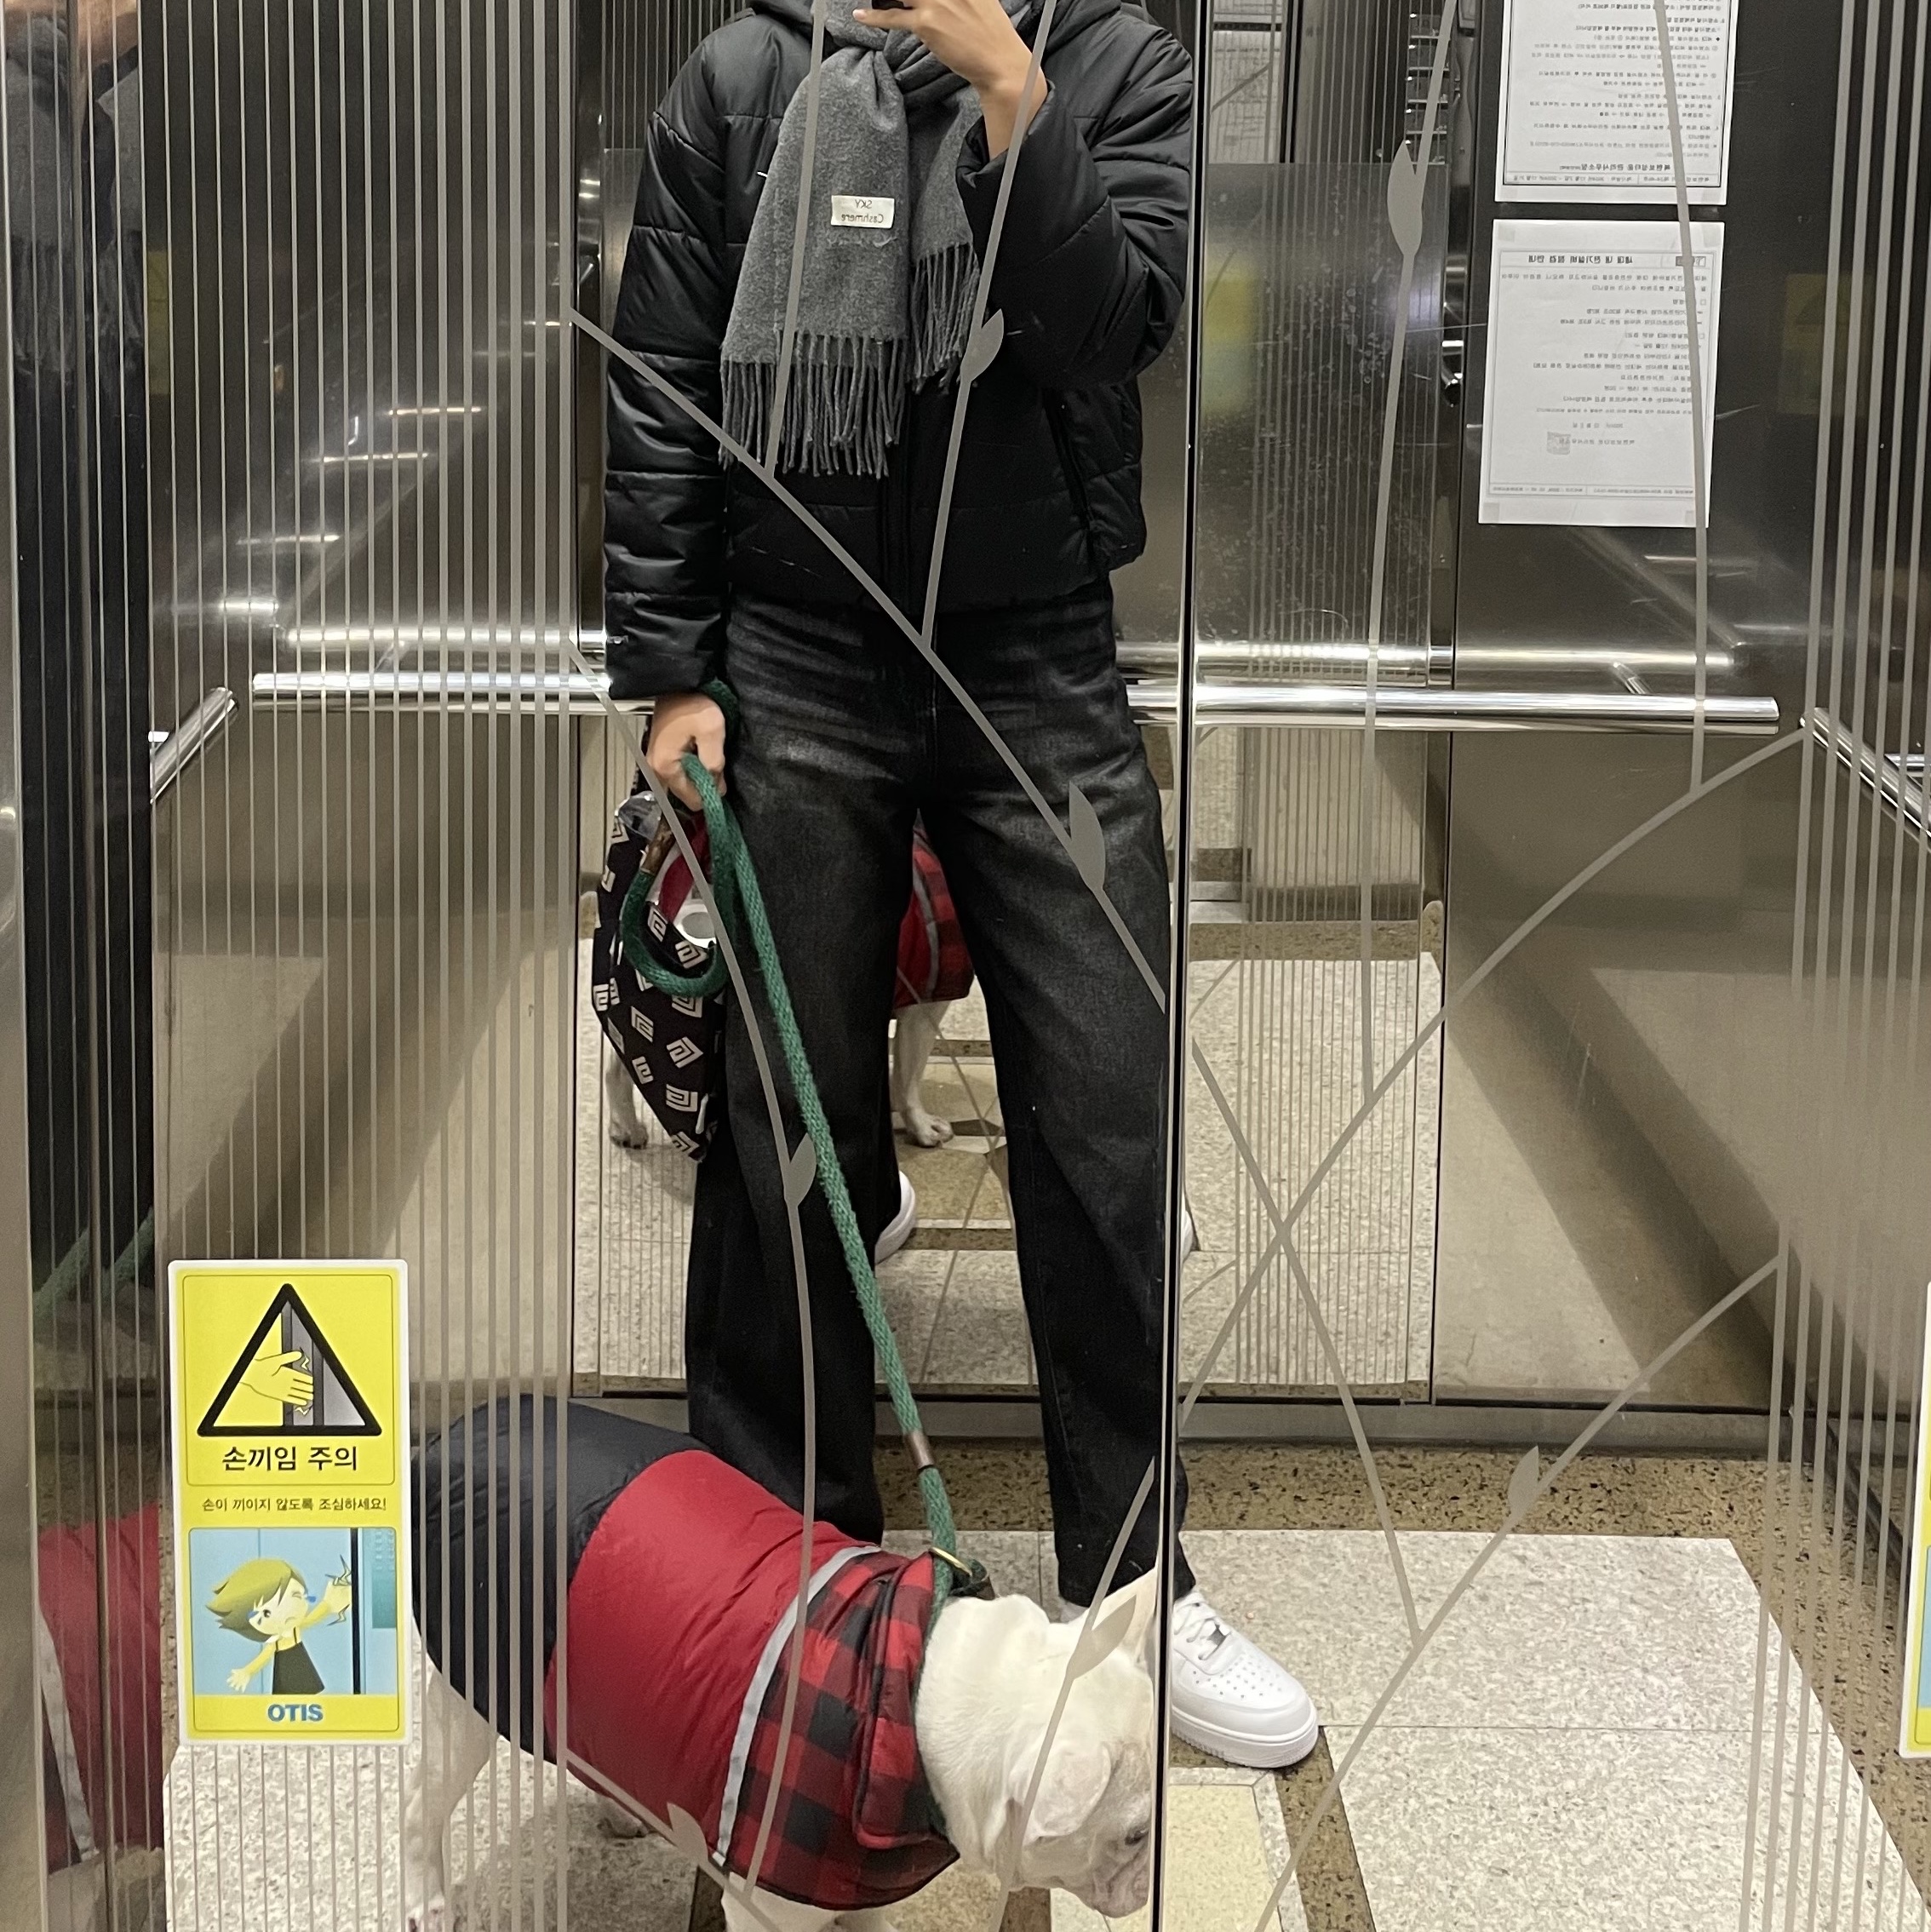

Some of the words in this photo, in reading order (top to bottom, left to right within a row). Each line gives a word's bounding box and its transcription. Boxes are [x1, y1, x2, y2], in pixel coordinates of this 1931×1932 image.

[222, 1446, 297, 1472] 손끼임
[307, 1446, 358, 1472] 주의
[202, 1498, 228, 1512] 손이
[232, 1498, 271, 1511] 끼이지
[276, 1498, 314, 1511] 않도록
[318, 1497, 387, 1511] 조심하세요!
[266, 1704, 324, 1723] OTIS
